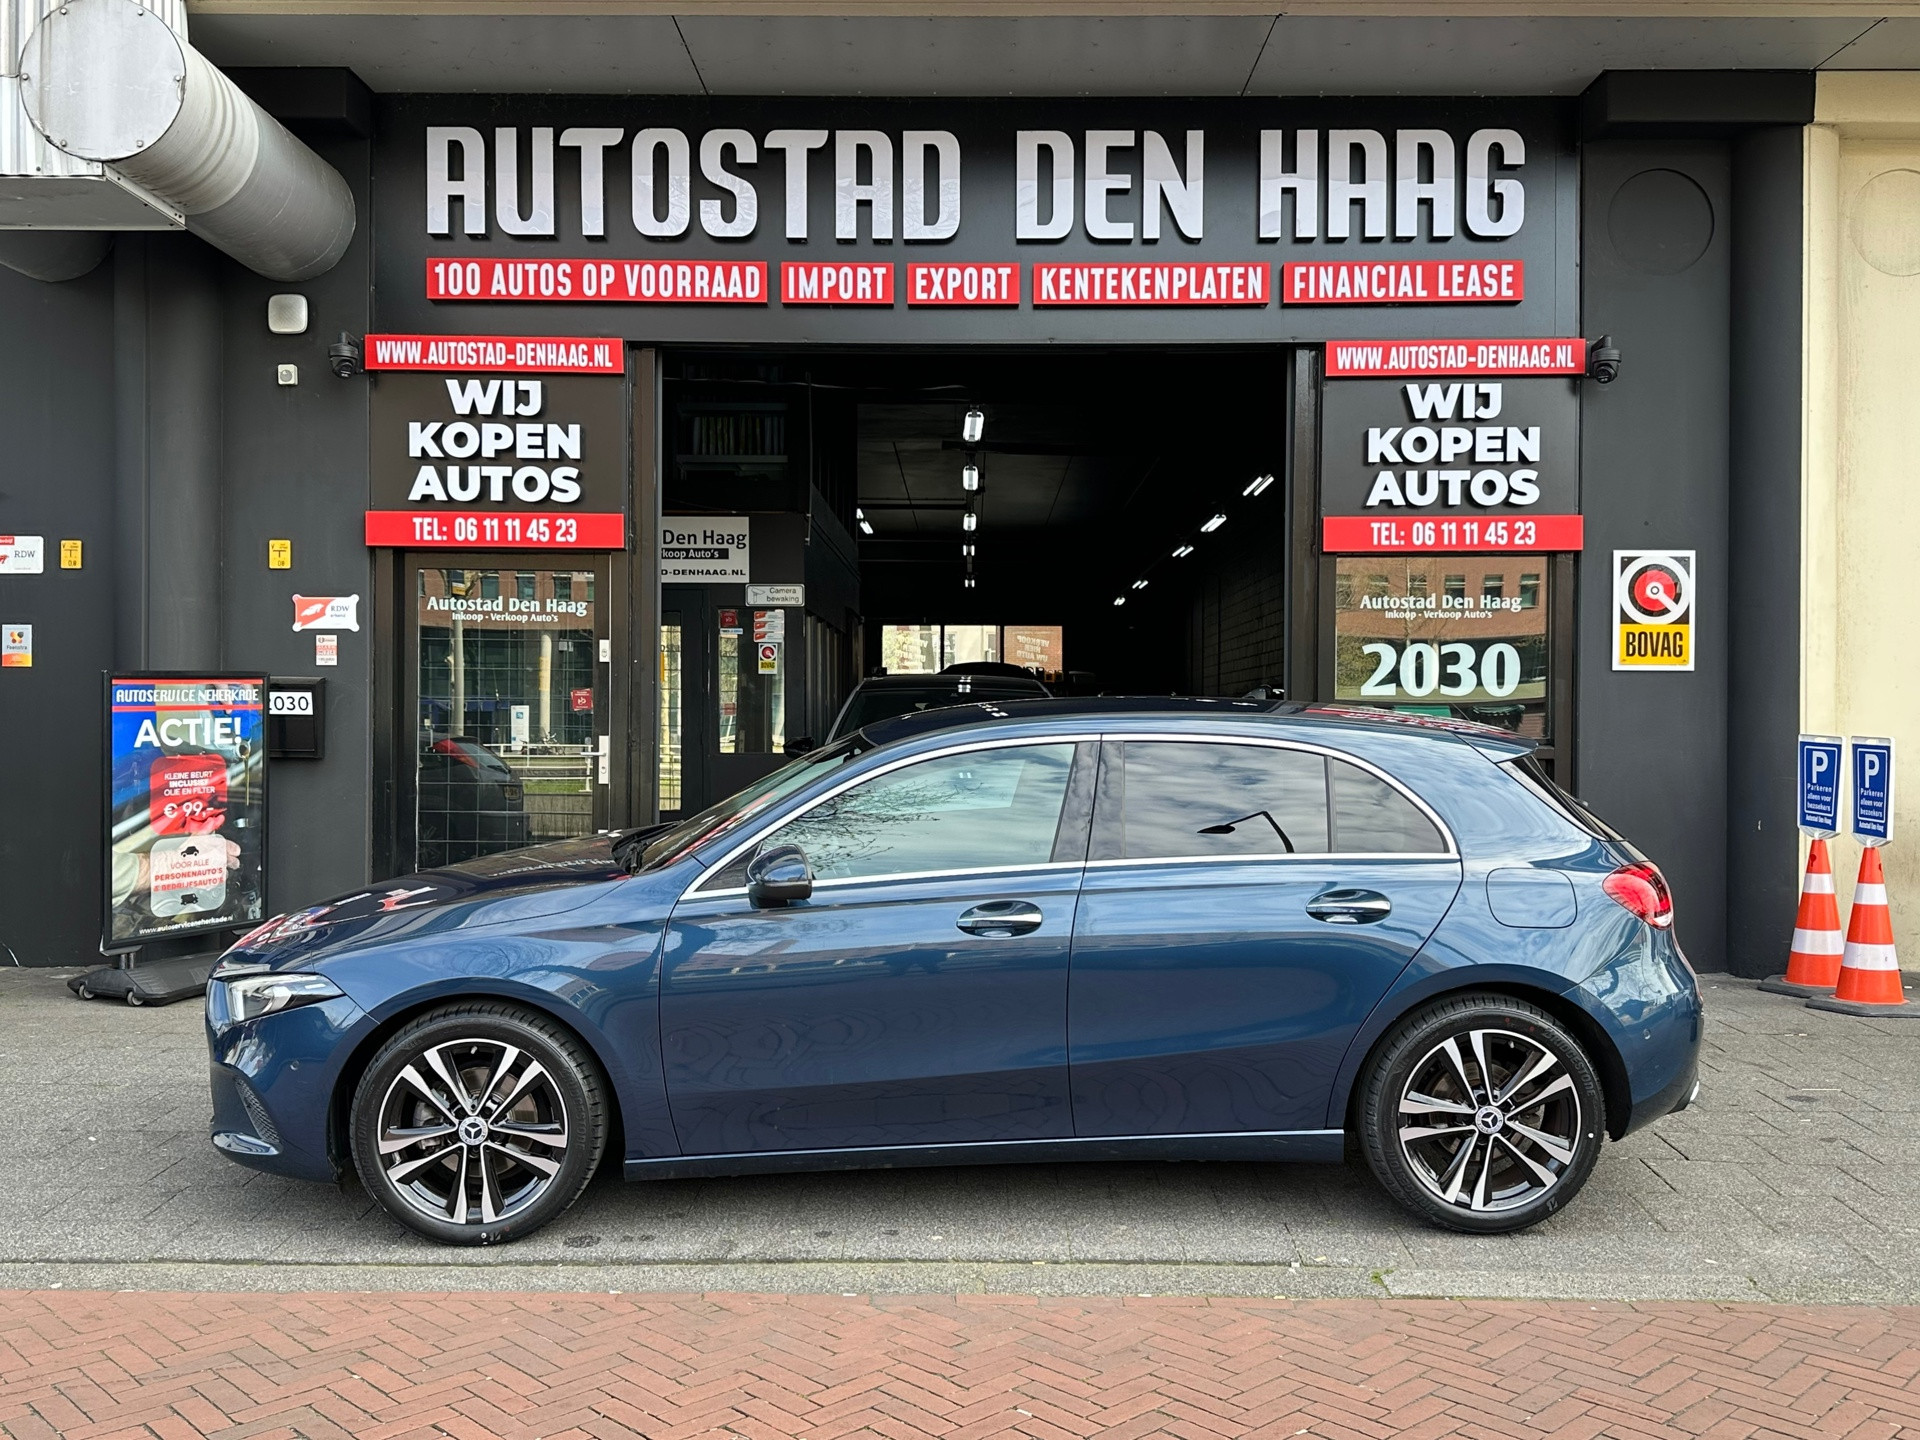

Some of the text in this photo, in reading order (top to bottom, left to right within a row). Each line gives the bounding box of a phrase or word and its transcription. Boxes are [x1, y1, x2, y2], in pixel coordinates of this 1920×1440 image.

[427, 126, 1526, 240] AUTOSTAD DEN HAAG
[434, 262, 761, 298] 100 AUTOS OP VOORRAAD
[787, 266, 887, 300] IMPORT
[915, 266, 1012, 300] EXPORT
[1041, 266, 1263, 300] KENTEKENPLATEN
[1293, 263, 1515, 298] FINANCIAL LEASE
[375, 340, 613, 368] WWW.AUTOSTAD-DENHAAG.NL
[1336, 345, 1575, 370] WWW.AUTOSTAD-DENHAAG.NL
[445, 379, 542, 416] WIJ
[1405, 383, 1503, 419] WIJ
[408, 421, 581, 460] KOPEN
[1367, 426, 1541, 463] KOPEN
[407, 465, 582, 503] AUTOS
[1365, 469, 1540, 507] AUTOS
[412, 517, 578, 542] TEL: 06 11 11 45 23
[662, 529, 747, 549] Den Haag
[1370, 521, 1536, 546] TEL: 06 11 11 45 23
[14, 550, 36, 558] RDW
[661, 549, 719, 560] koop Auto's
[426, 596, 588, 617] Autostad Den Haag
[766, 595, 800, 604] bewaking
[1360, 593, 1522, 612] Autostad Den Haag
[452, 612, 484, 623] Inkoop
[490, 613, 529, 623] Verkoop
[530, 613, 559, 623] Auto's
[1385, 610, 1417, 620] Inkoop
[1424, 610, 1462, 620] Verkoop
[1463, 610, 1493, 619] Auto's
[1625, 631, 1684, 658] BOVAG
[1360, 642, 1522, 697] 2030
[134, 717, 242, 748] ACTIE!
[164, 770, 213, 780] KLEINE BEURT
[1812, 750, 1829, 784] P
[1864, 753, 1880, 788] P
[164, 786, 215, 796] OLIE EN FILTER
[169, 778, 209, 788] INCLUSIEF
[1807, 783, 1832, 793] Parkeren
[1860, 787, 1884, 798] Parkeren
[164, 803, 177, 818] €
[154, 867, 223, 882] PERSONENAUTO'S
[171, 860, 192, 870] VOOR
[161, 876, 224, 891] BEDRIJFSAUTO'S
